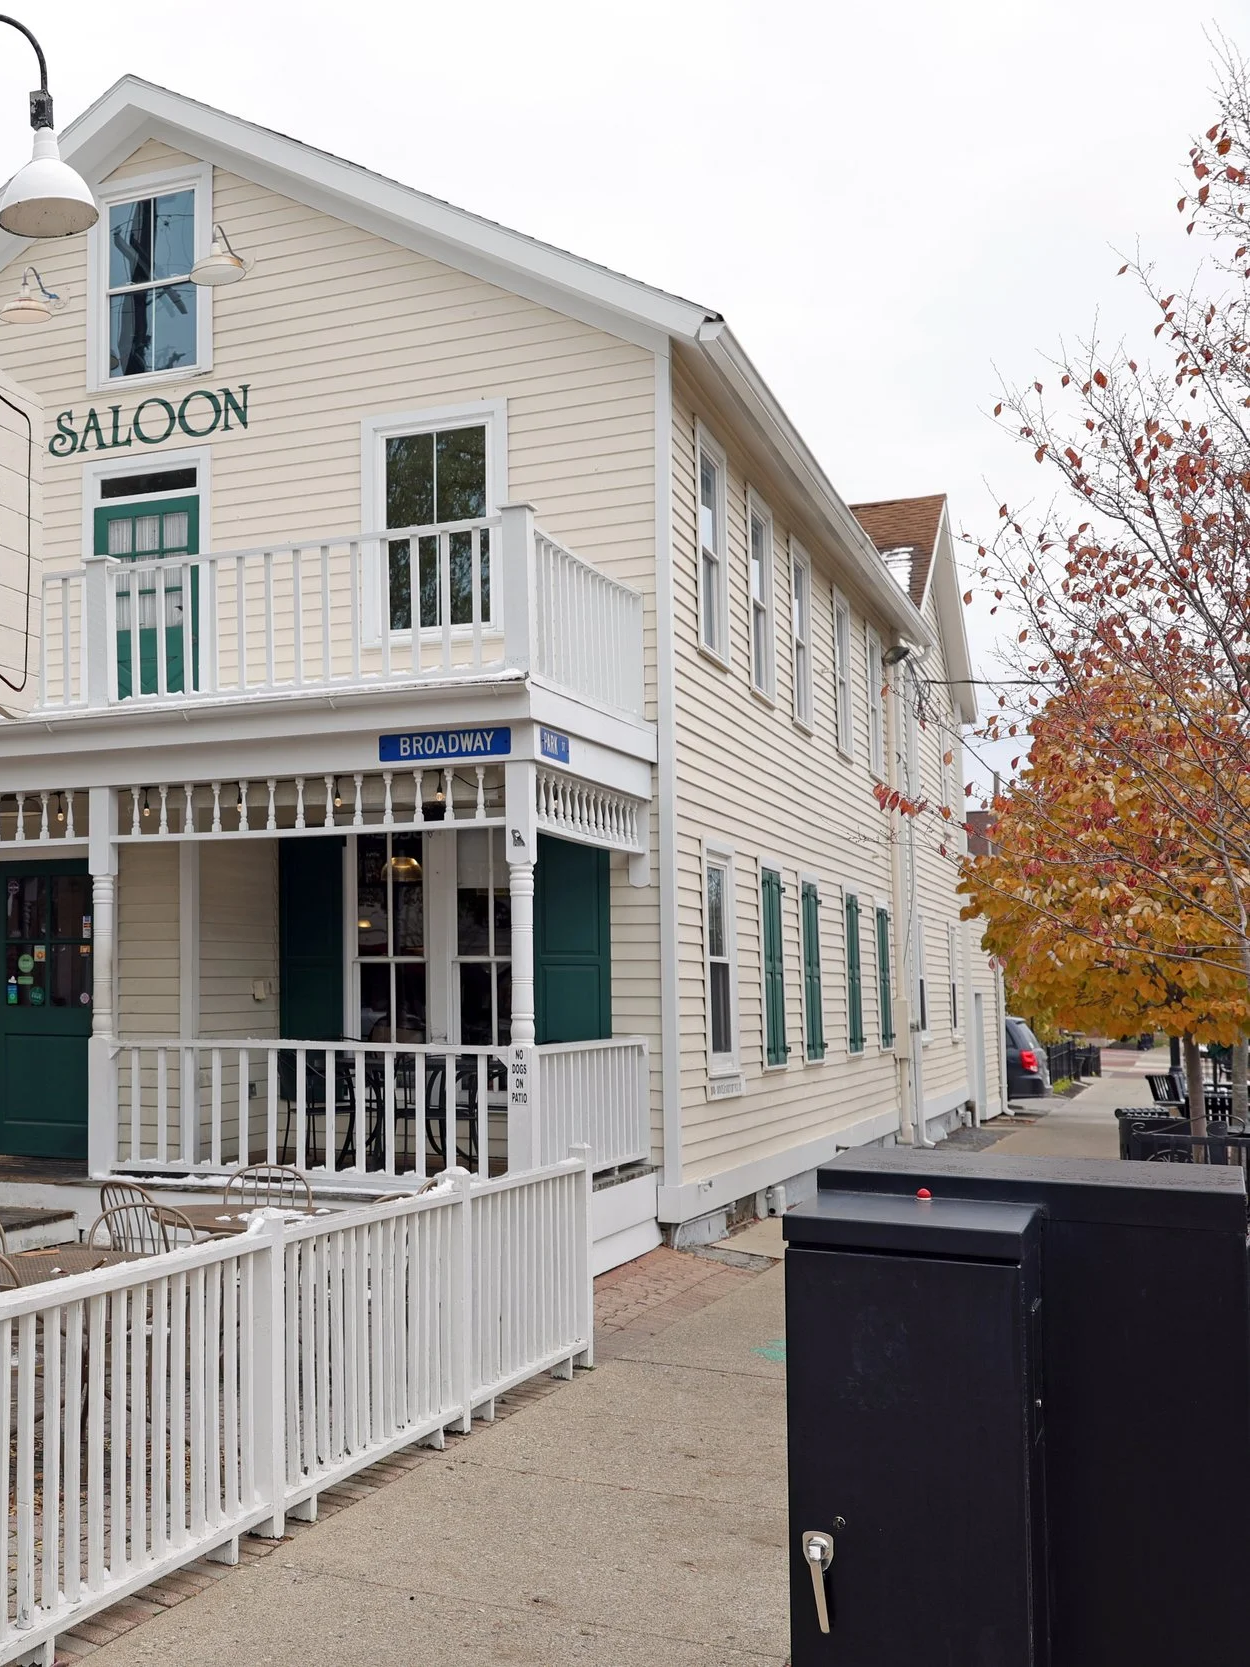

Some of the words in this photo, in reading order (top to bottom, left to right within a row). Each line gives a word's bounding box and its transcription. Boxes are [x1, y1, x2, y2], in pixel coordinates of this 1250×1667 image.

[48, 384, 251, 458] SALOON
[400, 731, 495, 757] BROADWAY
[543, 732, 559, 756] PARK
[515, 1049, 524, 1060] NO
[511, 1063, 528, 1075] DOGS
[515, 1078, 524, 1089] ON
[511, 1092, 528, 1104] PATIO
